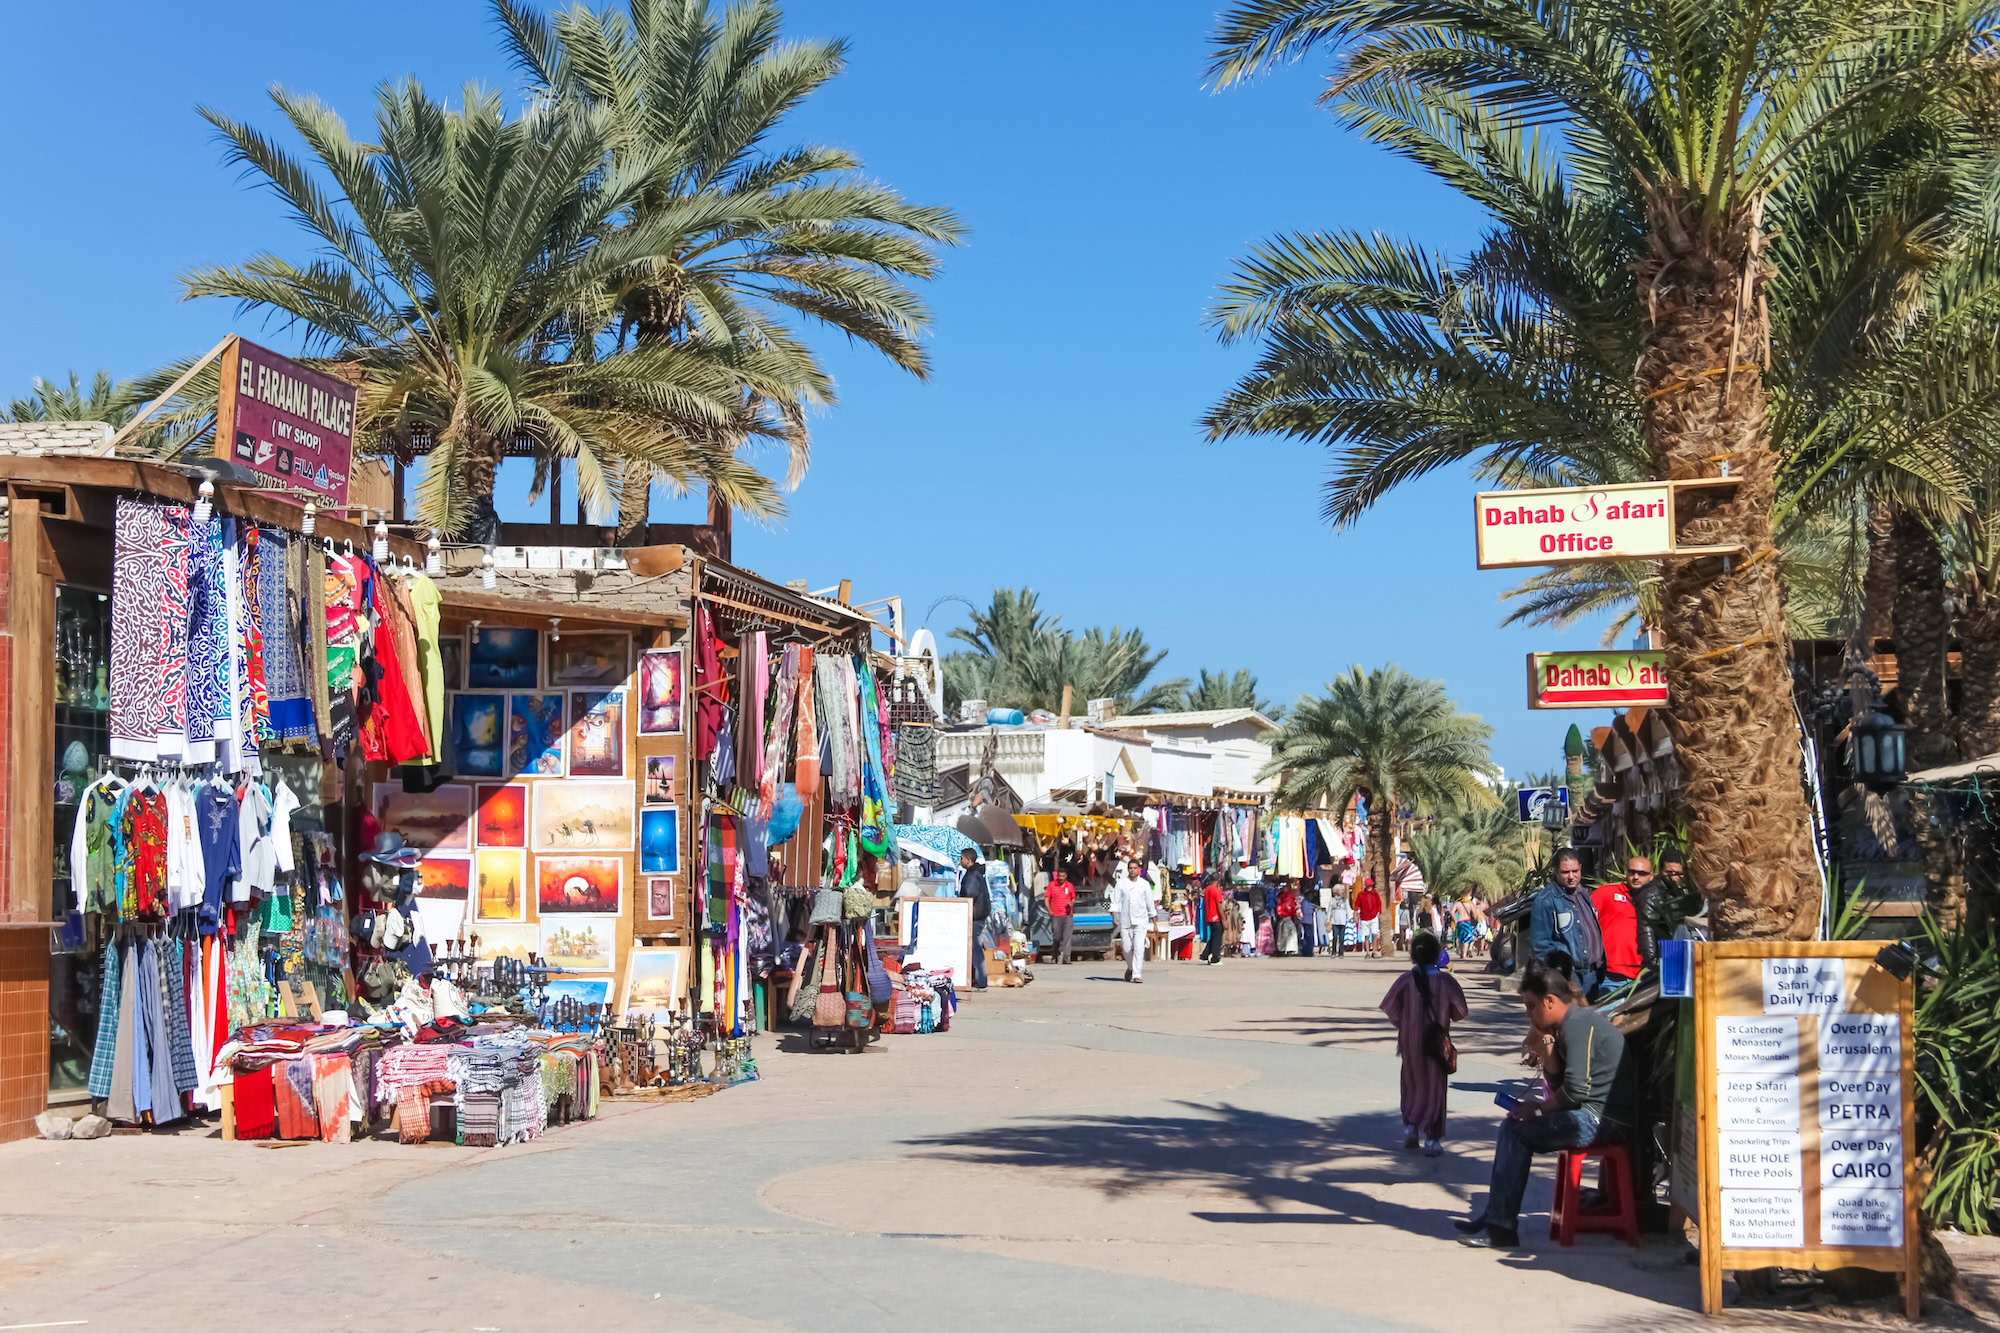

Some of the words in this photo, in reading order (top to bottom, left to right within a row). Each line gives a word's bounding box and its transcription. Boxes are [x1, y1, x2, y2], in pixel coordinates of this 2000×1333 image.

[240, 357, 254, 397] EL
[257, 364, 308, 420] FARAANA
[311, 387, 352, 437] PALACE
[259, 440, 273, 455] NIKE
[293, 456, 314, 480] FILA
[1485, 505, 1565, 526] Dahab
[1571, 491, 1665, 522] Safari
[1539, 533, 1613, 553] Office
[1546, 663, 1610, 687] Dahab
[1773, 965, 1809, 975] Dahab
[1778, 980, 1809, 990] Safari
[1770, 994, 1804, 1006] Daily
[1806, 992, 1839, 1005] Trips
[1727, 1025, 1737, 1034] St
[1738, 1025, 1784, 1034] Catherine
[1732, 1038, 1782, 1048] Monastery
[1824, 1043, 1893, 1055] Jerusalem
[1724, 1053, 1750, 1061] Moses
[1751, 1053, 1790, 1061] Mountain
[1727, 1081, 1753, 1092] Jeep
[1755, 1081, 1788, 1091] Safari
[1829, 1082, 1862, 1093] Over
[1865, 1081, 1891, 1095] Day
[1727, 1095, 1758, 1103] Colored
[1759, 1096, 1789, 1105] Canyon
[1829, 1104, 1892, 1120] PETRA
[1731, 1117, 1755, 1125] White
[1757, 1117, 1786, 1126] Canyon
[1729, 1138, 1771, 1147] Snorkeling
[1772, 1138, 1791, 1147] Trips
[1831, 1140, 1864, 1151] Over
[1867, 1140, 1893, 1153] Day
[1729, 1154, 1757, 1163] BLUE
[1761, 1154, 1790, 1163] HOLE
[1728, 1168, 1761, 1178] Three
[1763, 1168, 1793, 1178] Pools
[1831, 1162, 1892, 1178] CAIRO
[1731, 1196, 1772, 1205] Snorkeling
[1774, 1196, 1793, 1205] Trips
[1837, 1198, 1863, 1208] Quad
[1865, 1198, 1885, 1207] bike
[1734, 1207, 1767, 1215] National
[1769, 1207, 1790, 1215] Parks
[1832, 1211, 1859, 1220] Horse
[1862, 1211, 1891, 1222] Riding
[1729, 1219, 1746, 1227] Ras
[1748, 1218, 1796, 1227] Mohamed
[1831, 1224, 1864, 1232] Bedouin
[1865, 1224, 1892, 1233] Dinner
[1731, 1232, 1746, 1240] Ras
